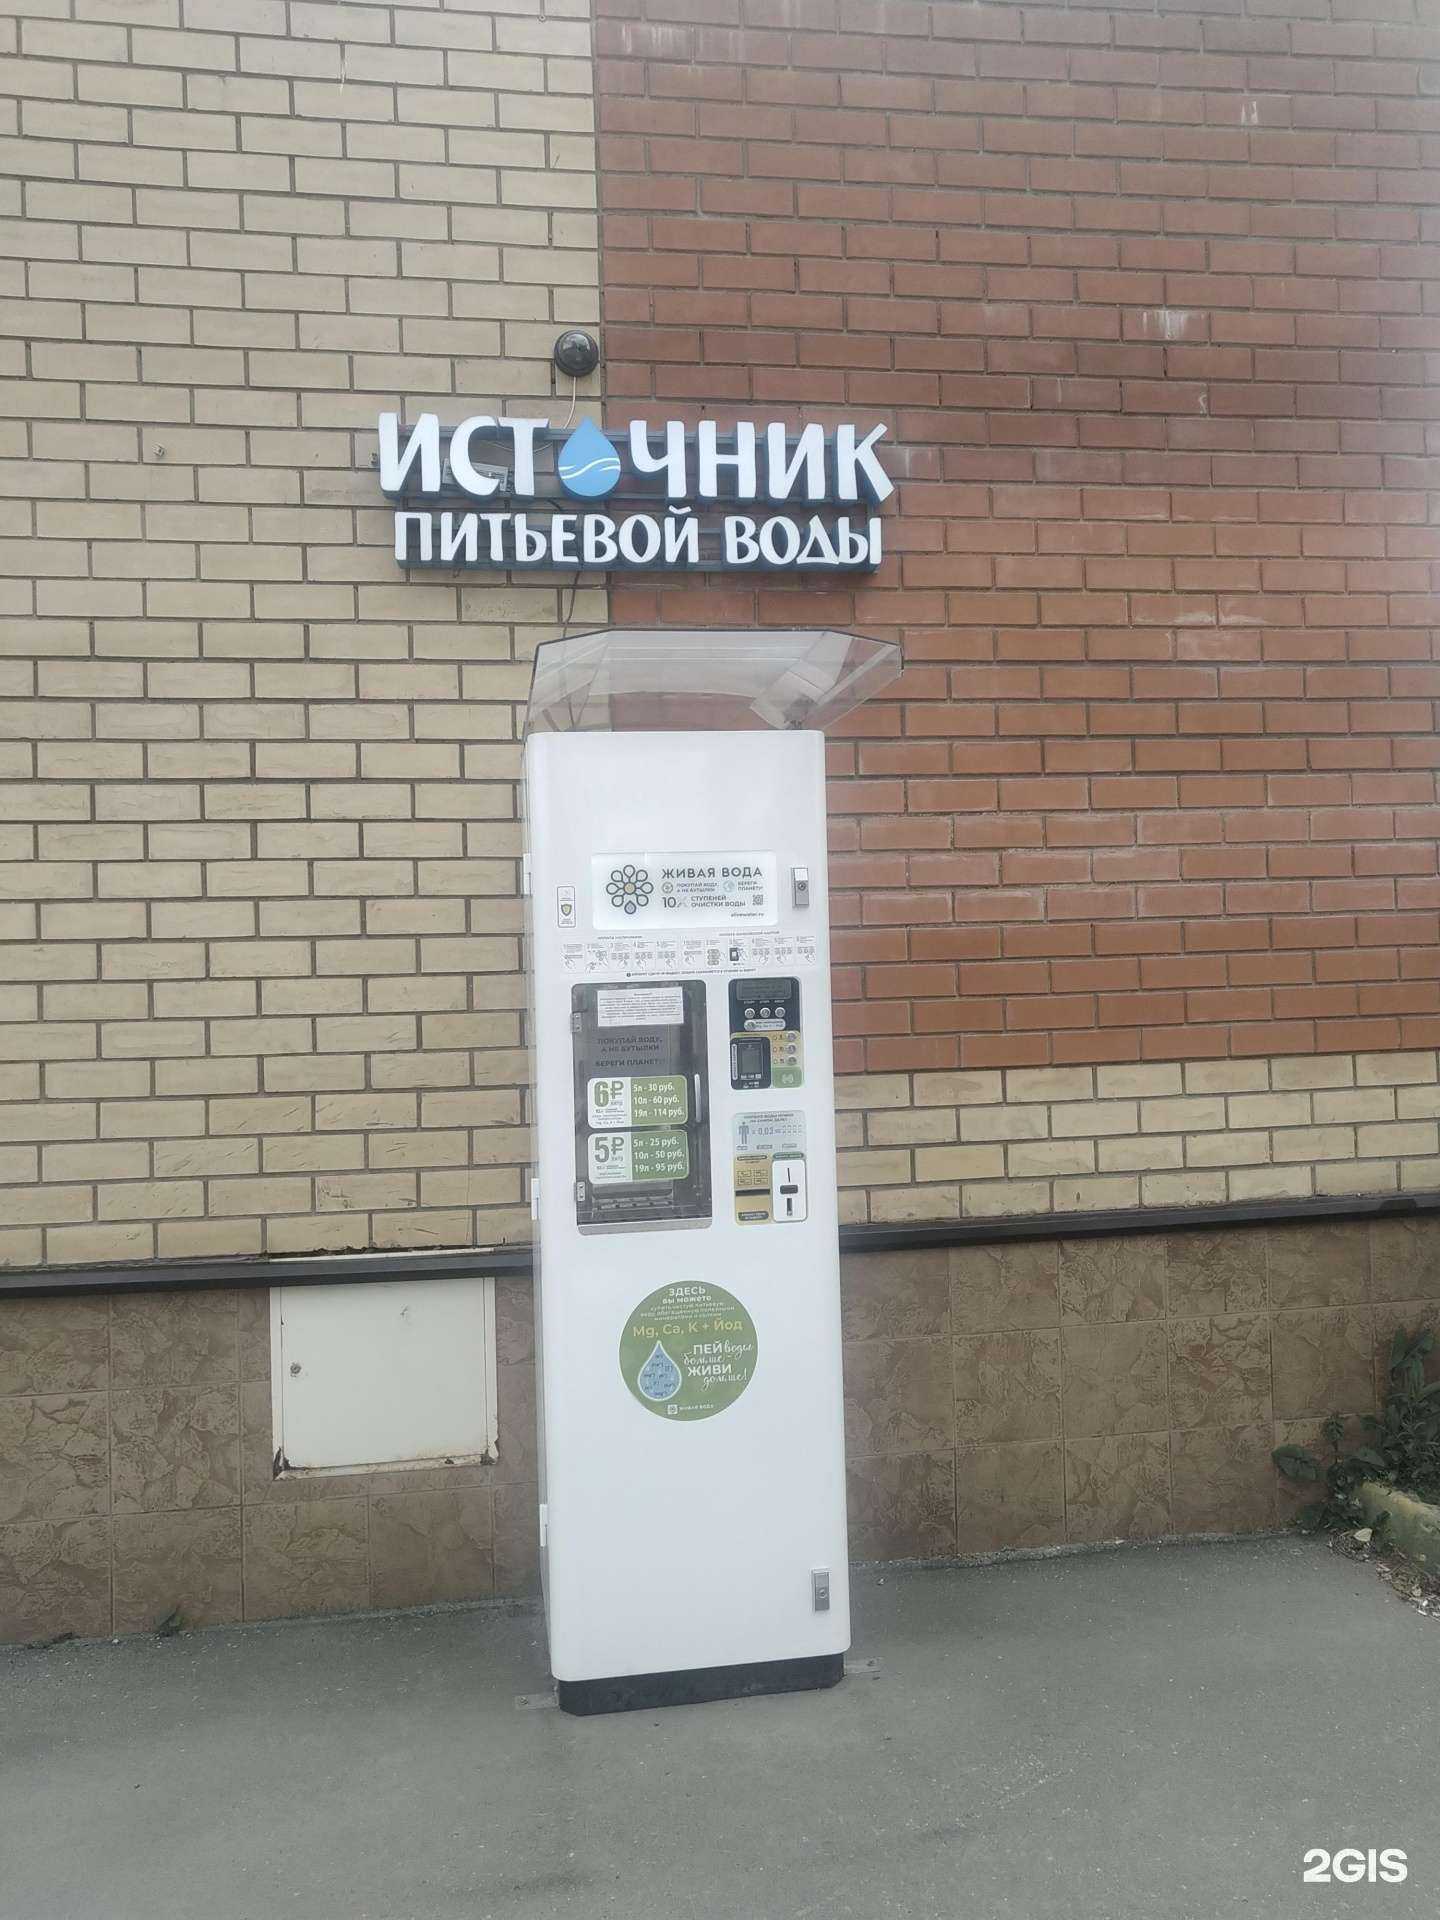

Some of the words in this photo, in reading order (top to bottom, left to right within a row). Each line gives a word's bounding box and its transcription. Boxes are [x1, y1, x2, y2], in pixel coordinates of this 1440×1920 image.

[394, 505, 700, 564] ПИТЬЕВОЙ
[724, 513, 882, 565] ВОДЫ
[661, 867, 716, 879] ЖИВАЯ
[721, 866, 763, 878] ВОДА
[661, 896, 677, 908] 10
[690, 894, 727, 902] СТУПЕНЕЙ
[724, 900, 746, 908] ВОДЫ
[647, 1083, 658, 1091] 30
[658, 1081, 676, 1093] руб.
[634, 1096, 648, 1105] 10л
[652, 1095, 663, 1104] 60
[663, 1094, 680, 1106] руб.
[634, 1109, 648, 1118] 19л
[653, 1107, 668, 1117] 114
[668, 1107, 686, 1118] руб.
[633, 1138, 644, 1148] 5л
[649, 1137, 660, 1146] 25
[661, 1136, 680, 1148] руб.
[634, 1151, 649, 1160] 10л
[655, 1149, 666, 1159] 50
[667, 1148, 685, 1160] руб.
[634, 1163, 649, 1173] 19л
[655, 1162, 666, 1172] 95
[667, 1161, 685, 1173] руб.
[668, 1286, 706, 1297] ЗДЕСЬ
[633, 1325, 659, 1338] Mg,
[662, 1323, 684, 1335] Ca,
[714, 1316, 743, 1332] Йод
[693, 1340, 722, 1355] ПЕЙ
[687, 1363, 732, 1377] ЖИВИ
